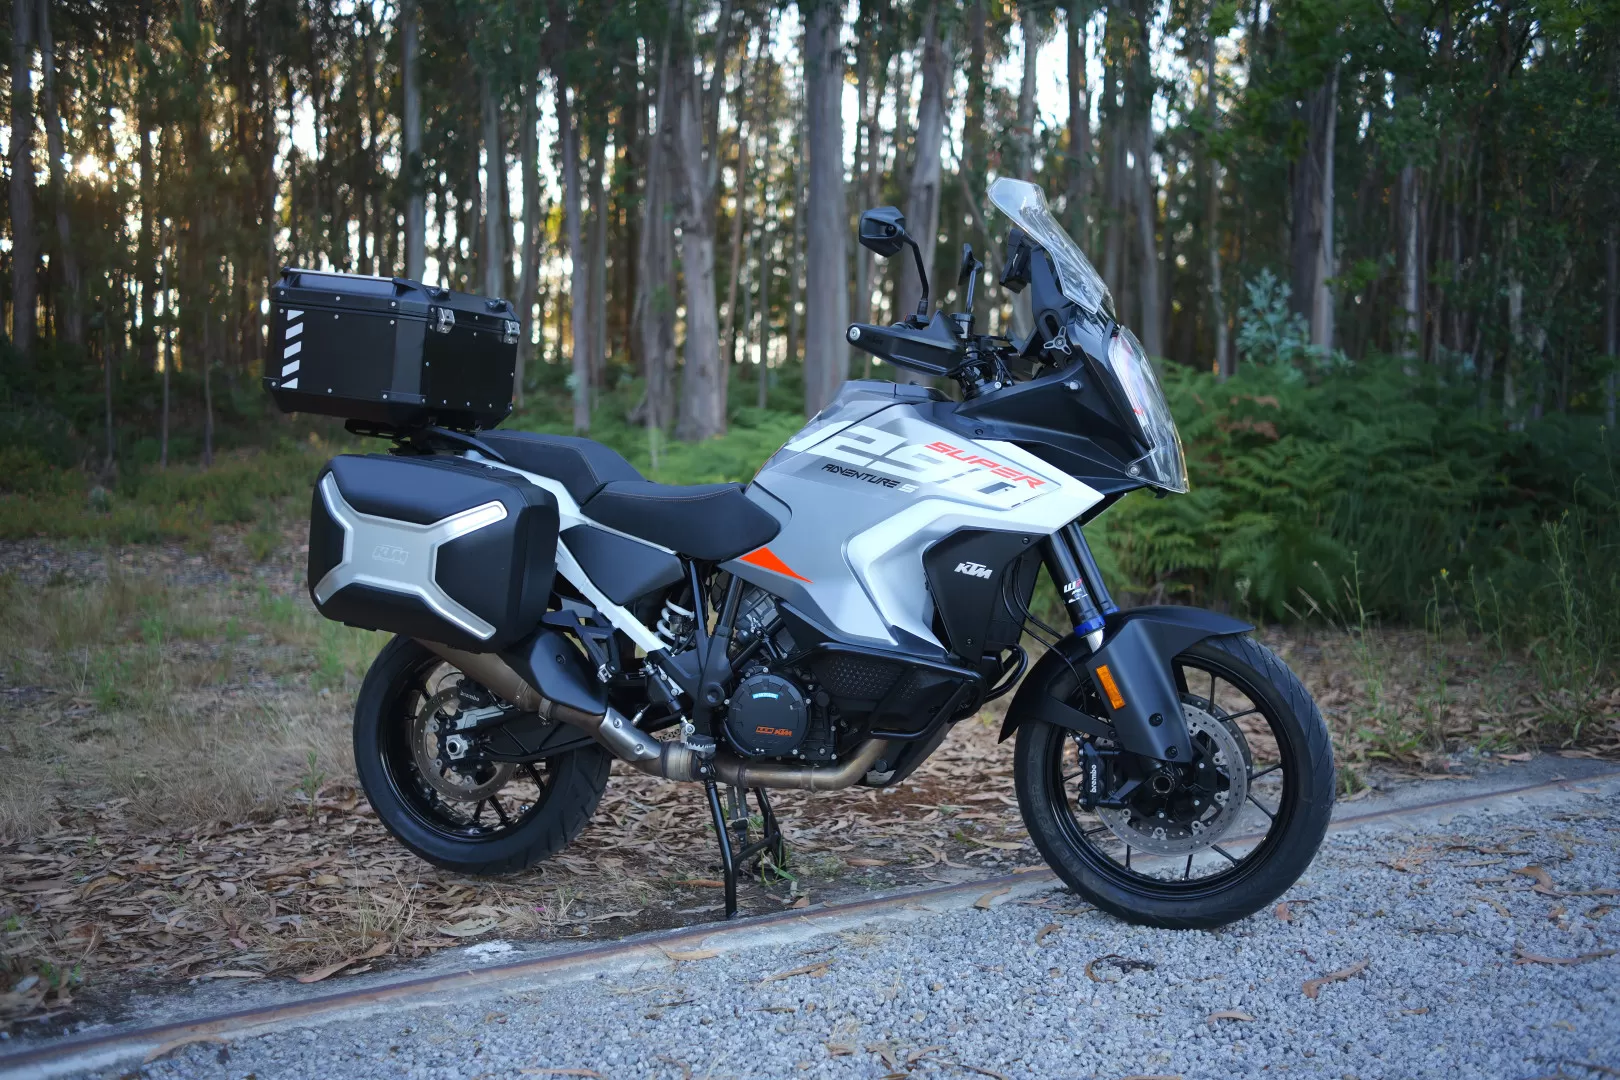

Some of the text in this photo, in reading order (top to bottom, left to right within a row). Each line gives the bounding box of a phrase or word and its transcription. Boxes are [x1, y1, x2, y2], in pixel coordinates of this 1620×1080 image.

[821, 463, 920, 494] ADVENTURE S
[924, 441, 1047, 490] SUPER
[954, 561, 993, 579] KTM
